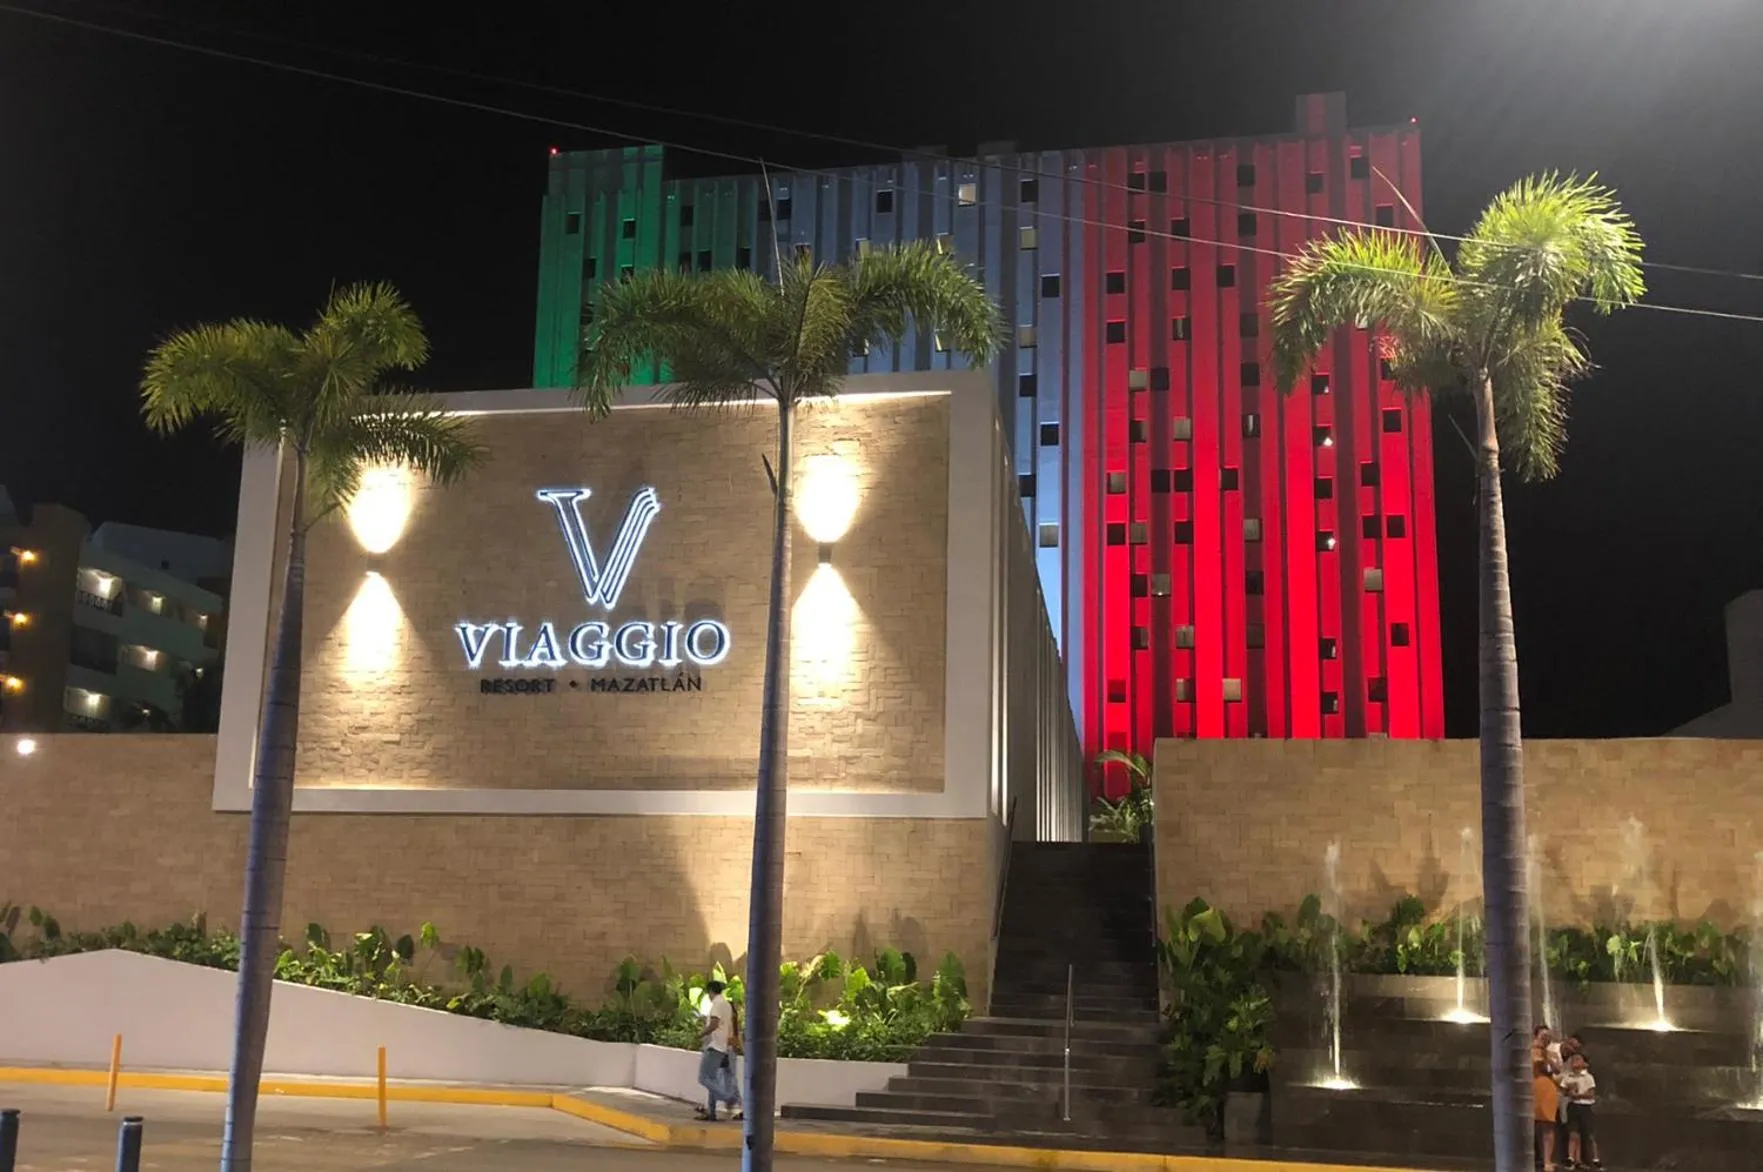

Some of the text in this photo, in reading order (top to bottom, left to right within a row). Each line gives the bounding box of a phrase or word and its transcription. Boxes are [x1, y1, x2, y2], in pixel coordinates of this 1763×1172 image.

[537, 487, 660, 609] V
[454, 620, 731, 667] VIAGGIO
[480, 671, 702, 694] RESORT MAZATLÁN
